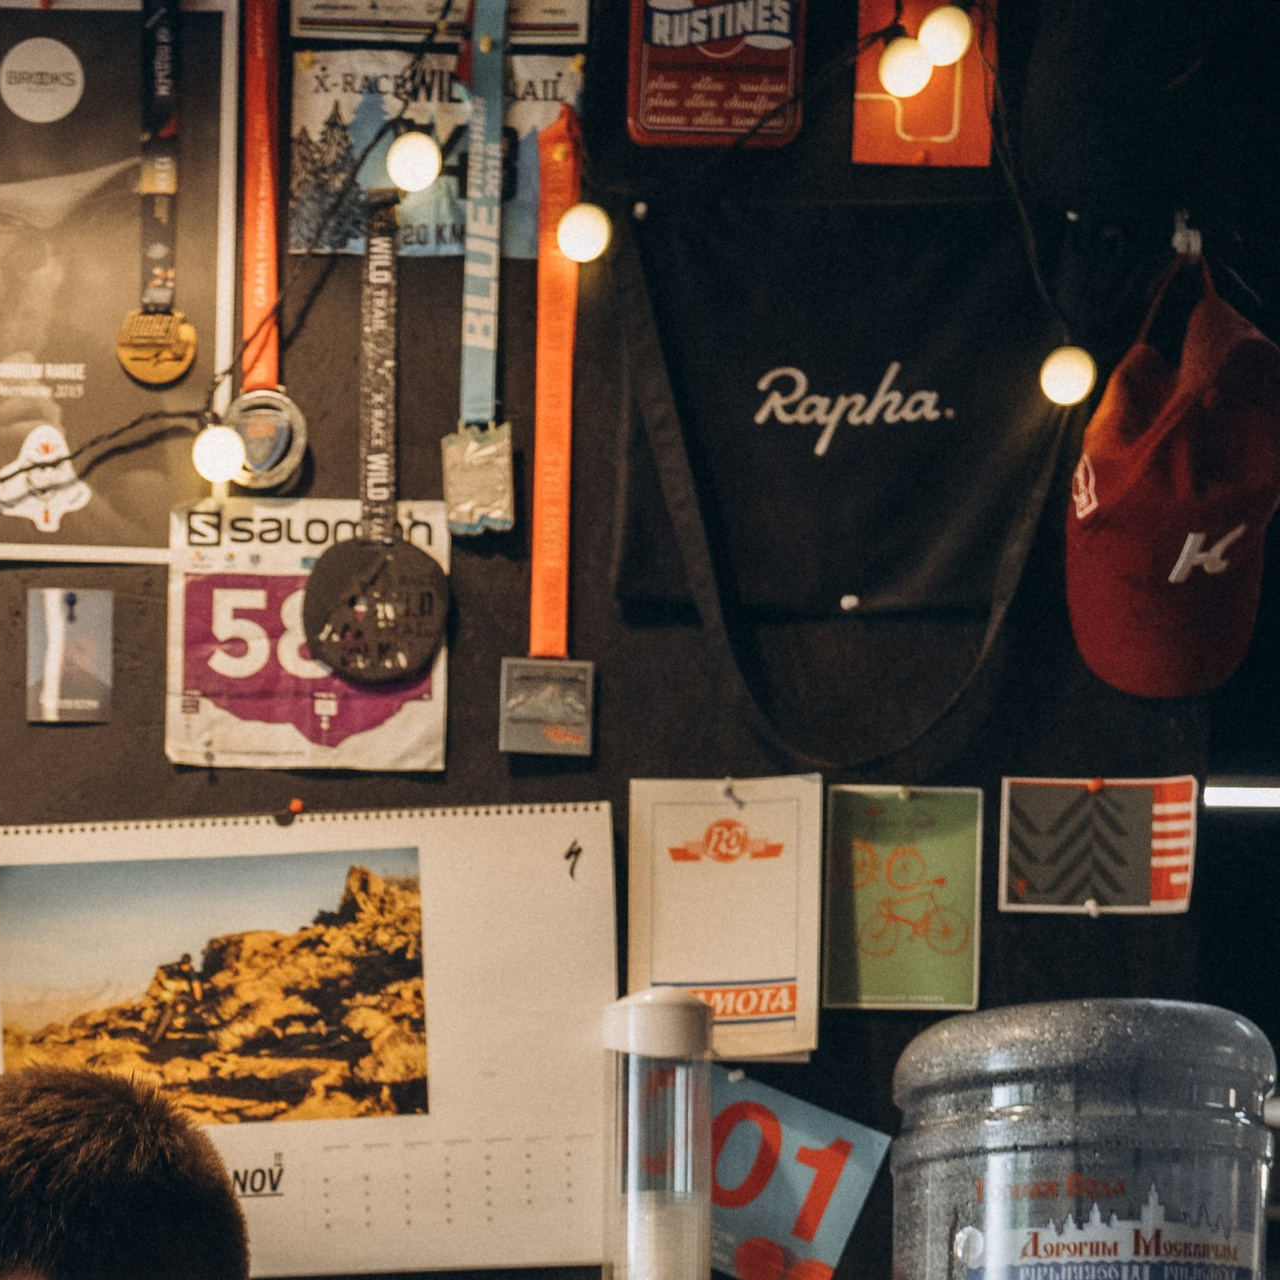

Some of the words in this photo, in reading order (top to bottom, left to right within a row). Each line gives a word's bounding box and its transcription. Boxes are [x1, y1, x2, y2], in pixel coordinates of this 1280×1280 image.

[651, 0, 791, 47] RUSTINES
[6, 70, 76, 88] BROOKS
[369, 236, 392, 284] WILD
[463, 199, 502, 351] BLUE
[365, 453, 390, 501] WILD
[233, 1166, 284, 1194] NOV
